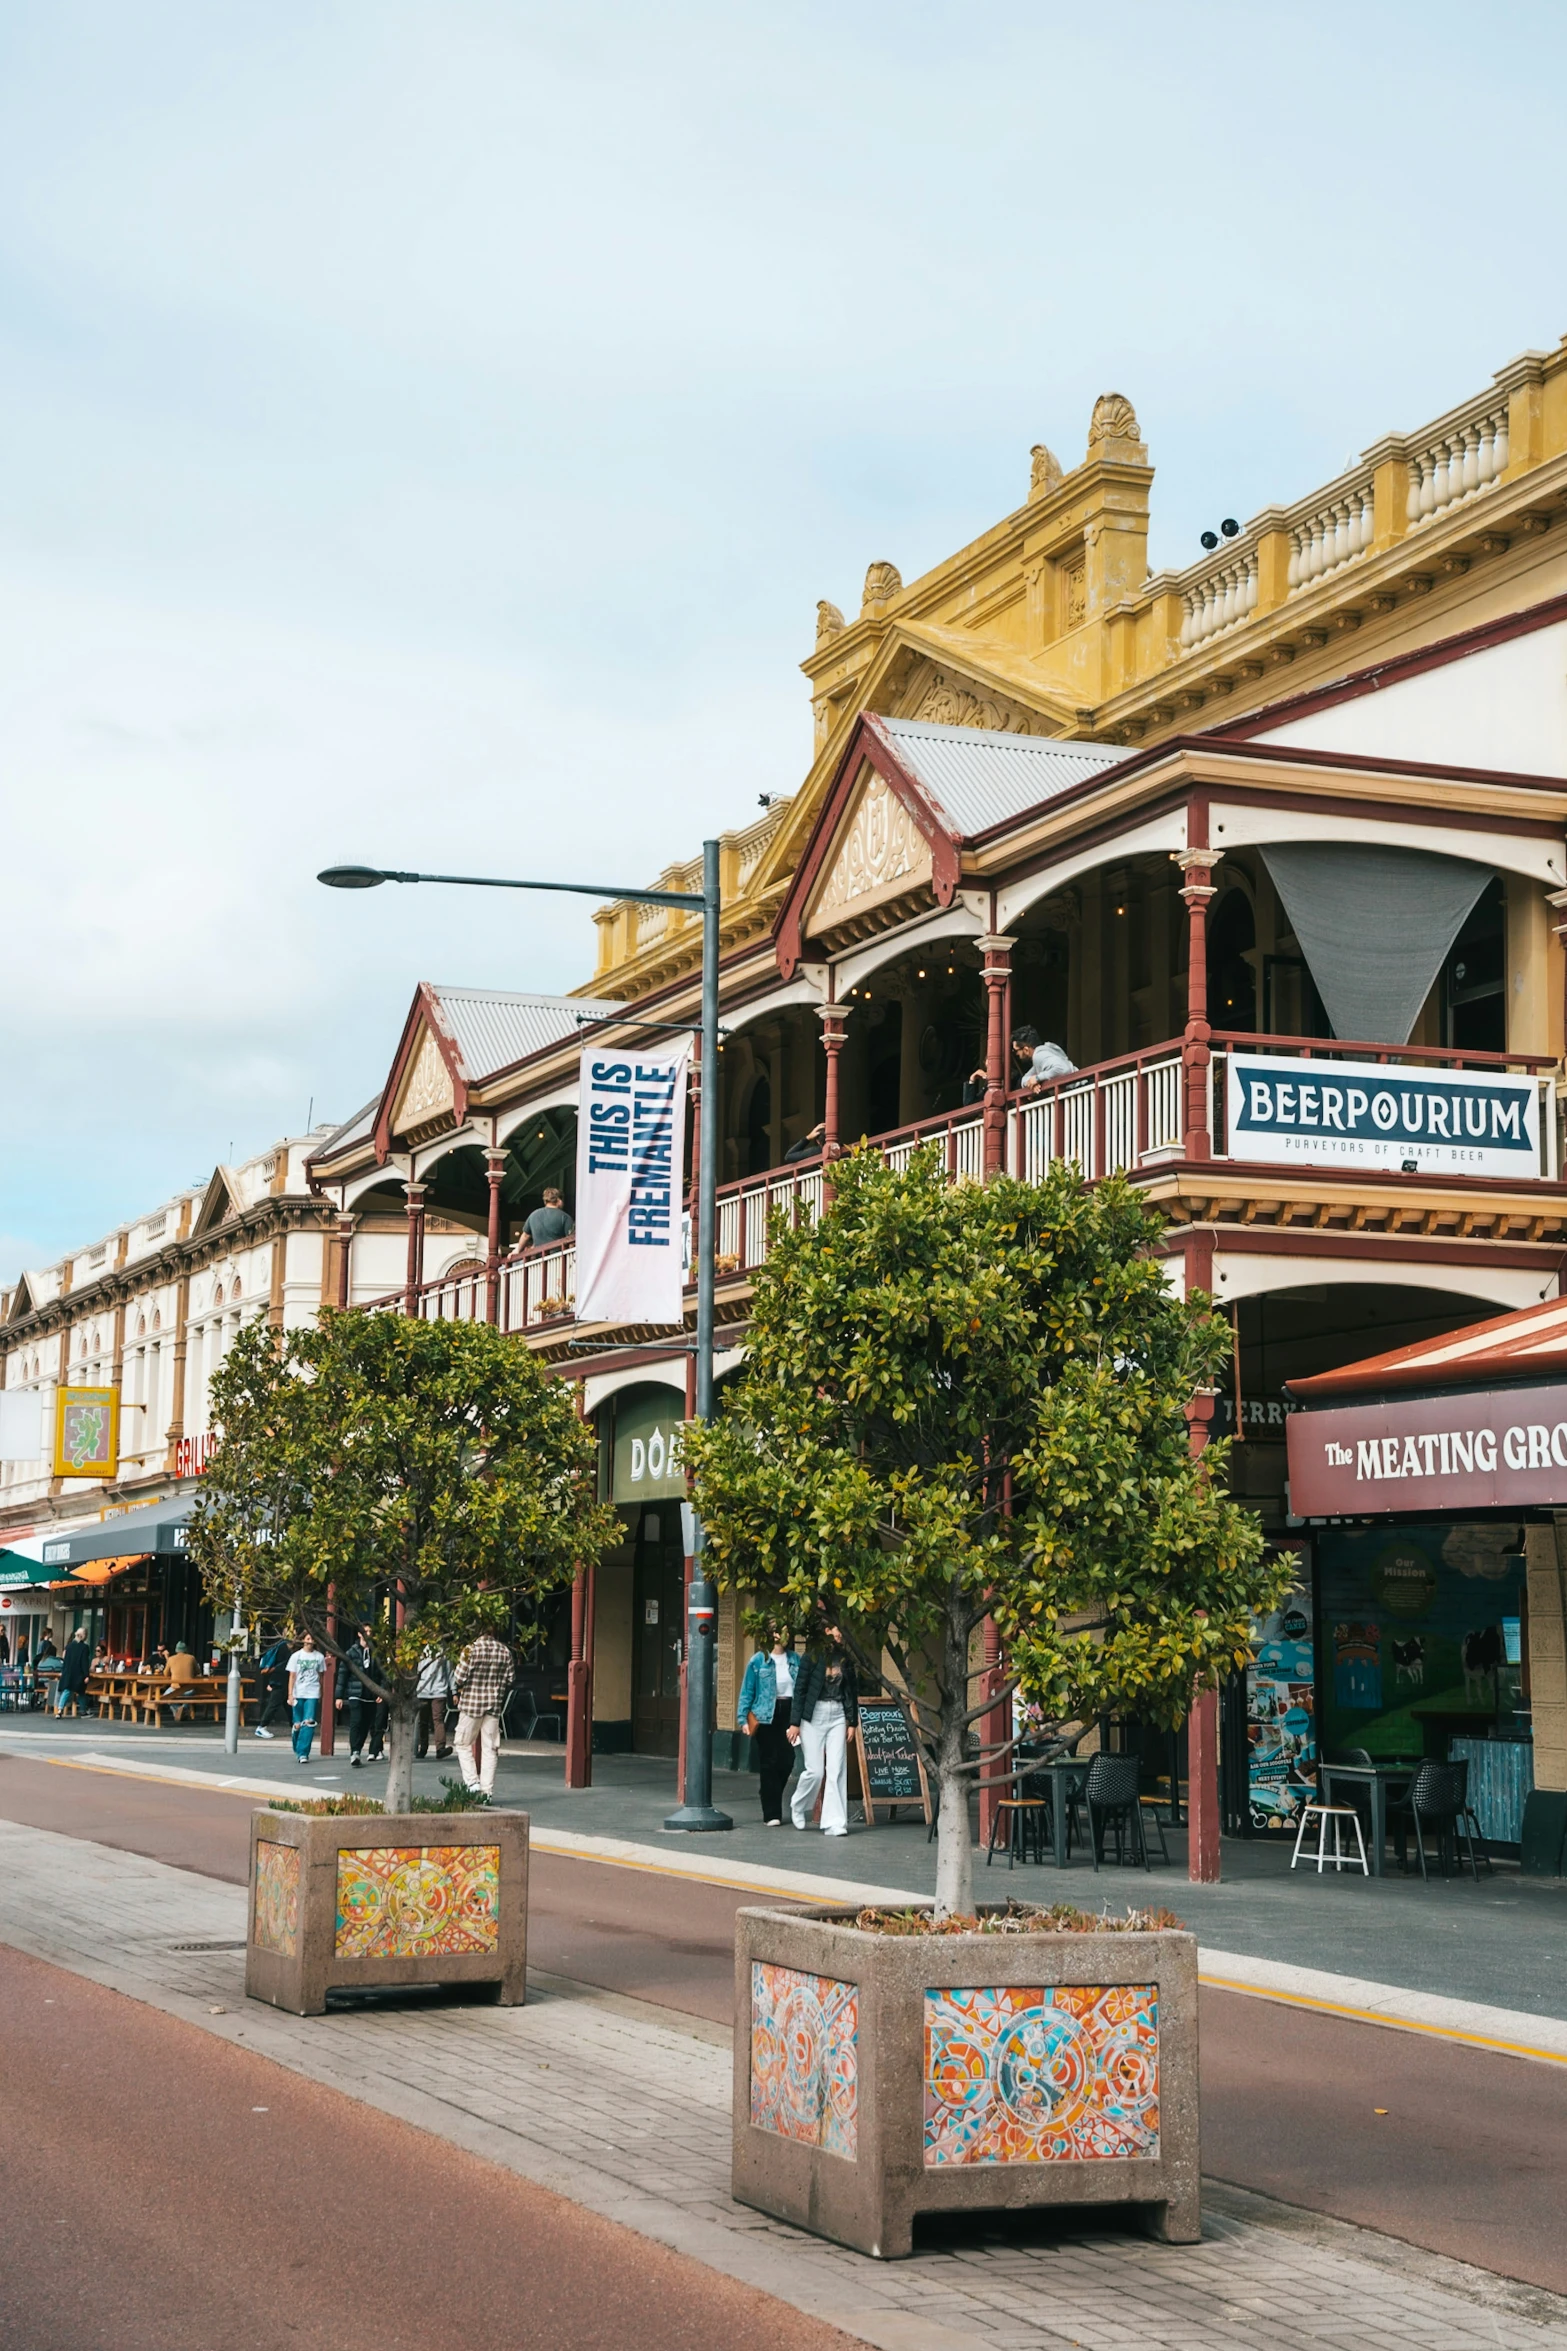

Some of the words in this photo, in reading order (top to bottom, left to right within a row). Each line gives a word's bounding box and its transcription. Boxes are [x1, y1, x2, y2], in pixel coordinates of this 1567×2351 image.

[591, 1062, 632, 1094] IS
[1249, 1080, 1522, 1140] BEERPOURIUM
[588, 1103, 630, 1174] THIS
[628, 1065, 676, 1246] FREMANTLE
[1286, 1138, 1364, 1153] PURVEYORS
[1375, 1144, 1388, 1155] OF
[1399, 1146, 1441, 1159] CRAFT
[1452, 1150, 1483, 1161] BEER
[1325, 1441, 1353, 1466] The
[1356, 1429, 1498, 1480] MEATING
[1384, 1567, 1426, 1578] Mission
[1395, 1558, 1415, 1567] Our
